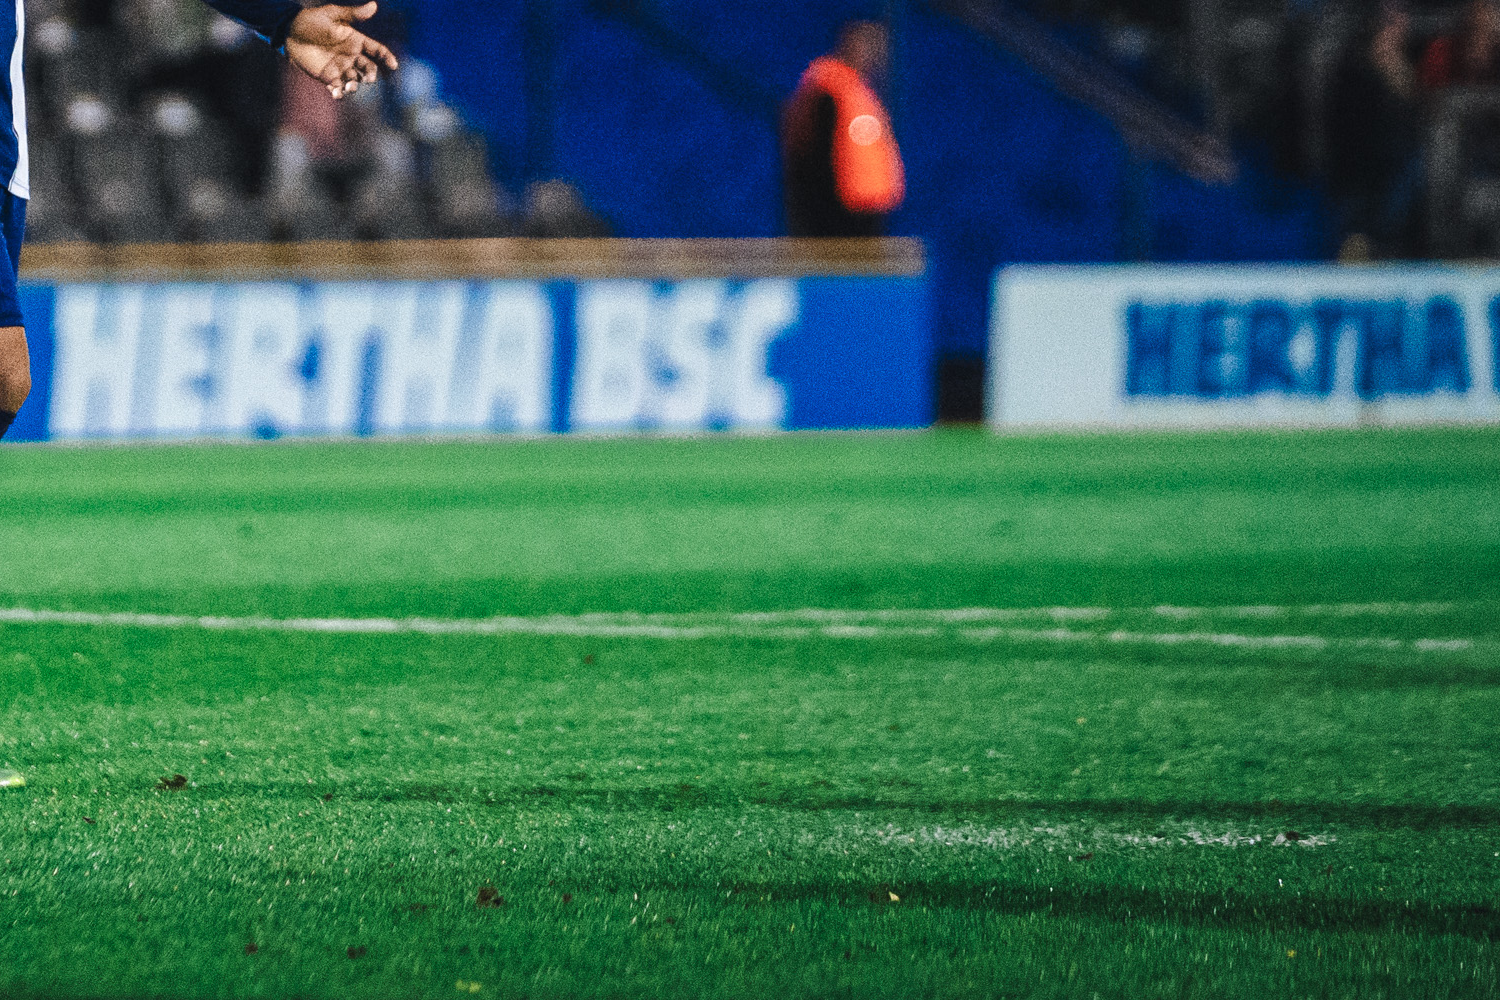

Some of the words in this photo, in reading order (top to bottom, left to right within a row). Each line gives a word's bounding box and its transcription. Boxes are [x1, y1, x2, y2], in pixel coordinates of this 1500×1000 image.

[52, 281, 556, 433] HERTHA
[570, 278, 798, 430] BSC
[1126, 297, 1472, 402] HERTHA
